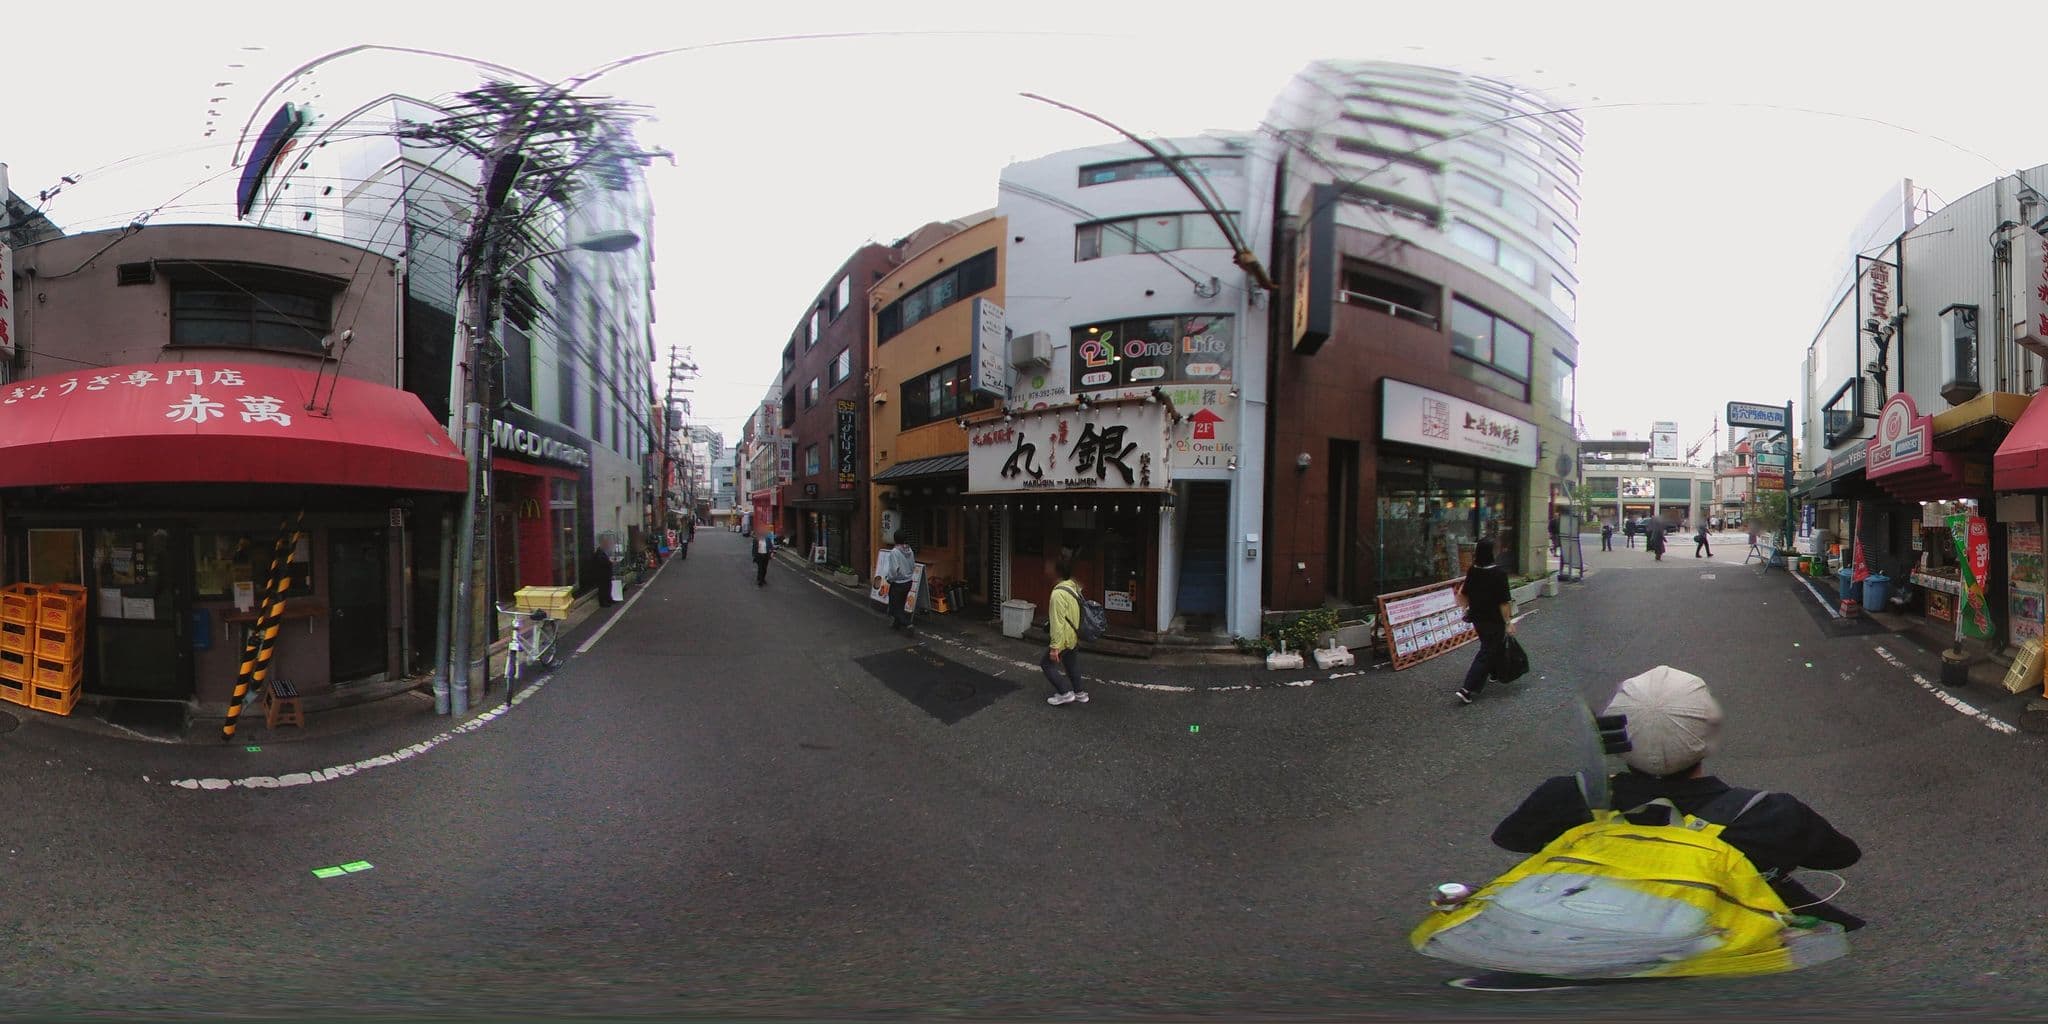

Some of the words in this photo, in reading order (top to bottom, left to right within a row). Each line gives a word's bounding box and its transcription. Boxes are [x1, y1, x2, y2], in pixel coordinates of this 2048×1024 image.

[1124, 339, 1173, 358] One
[1183, 335, 1226, 353] Life
[3, 368, 247, 404] ぎょうざ専門店
[165, 393, 293, 427] 赤萬
[1197, 423, 1212, 433] 2F
[1193, 442, 1214, 452] One
[1216, 442, 1233, 454] Life
[1193, 456, 1216, 466] 入口
